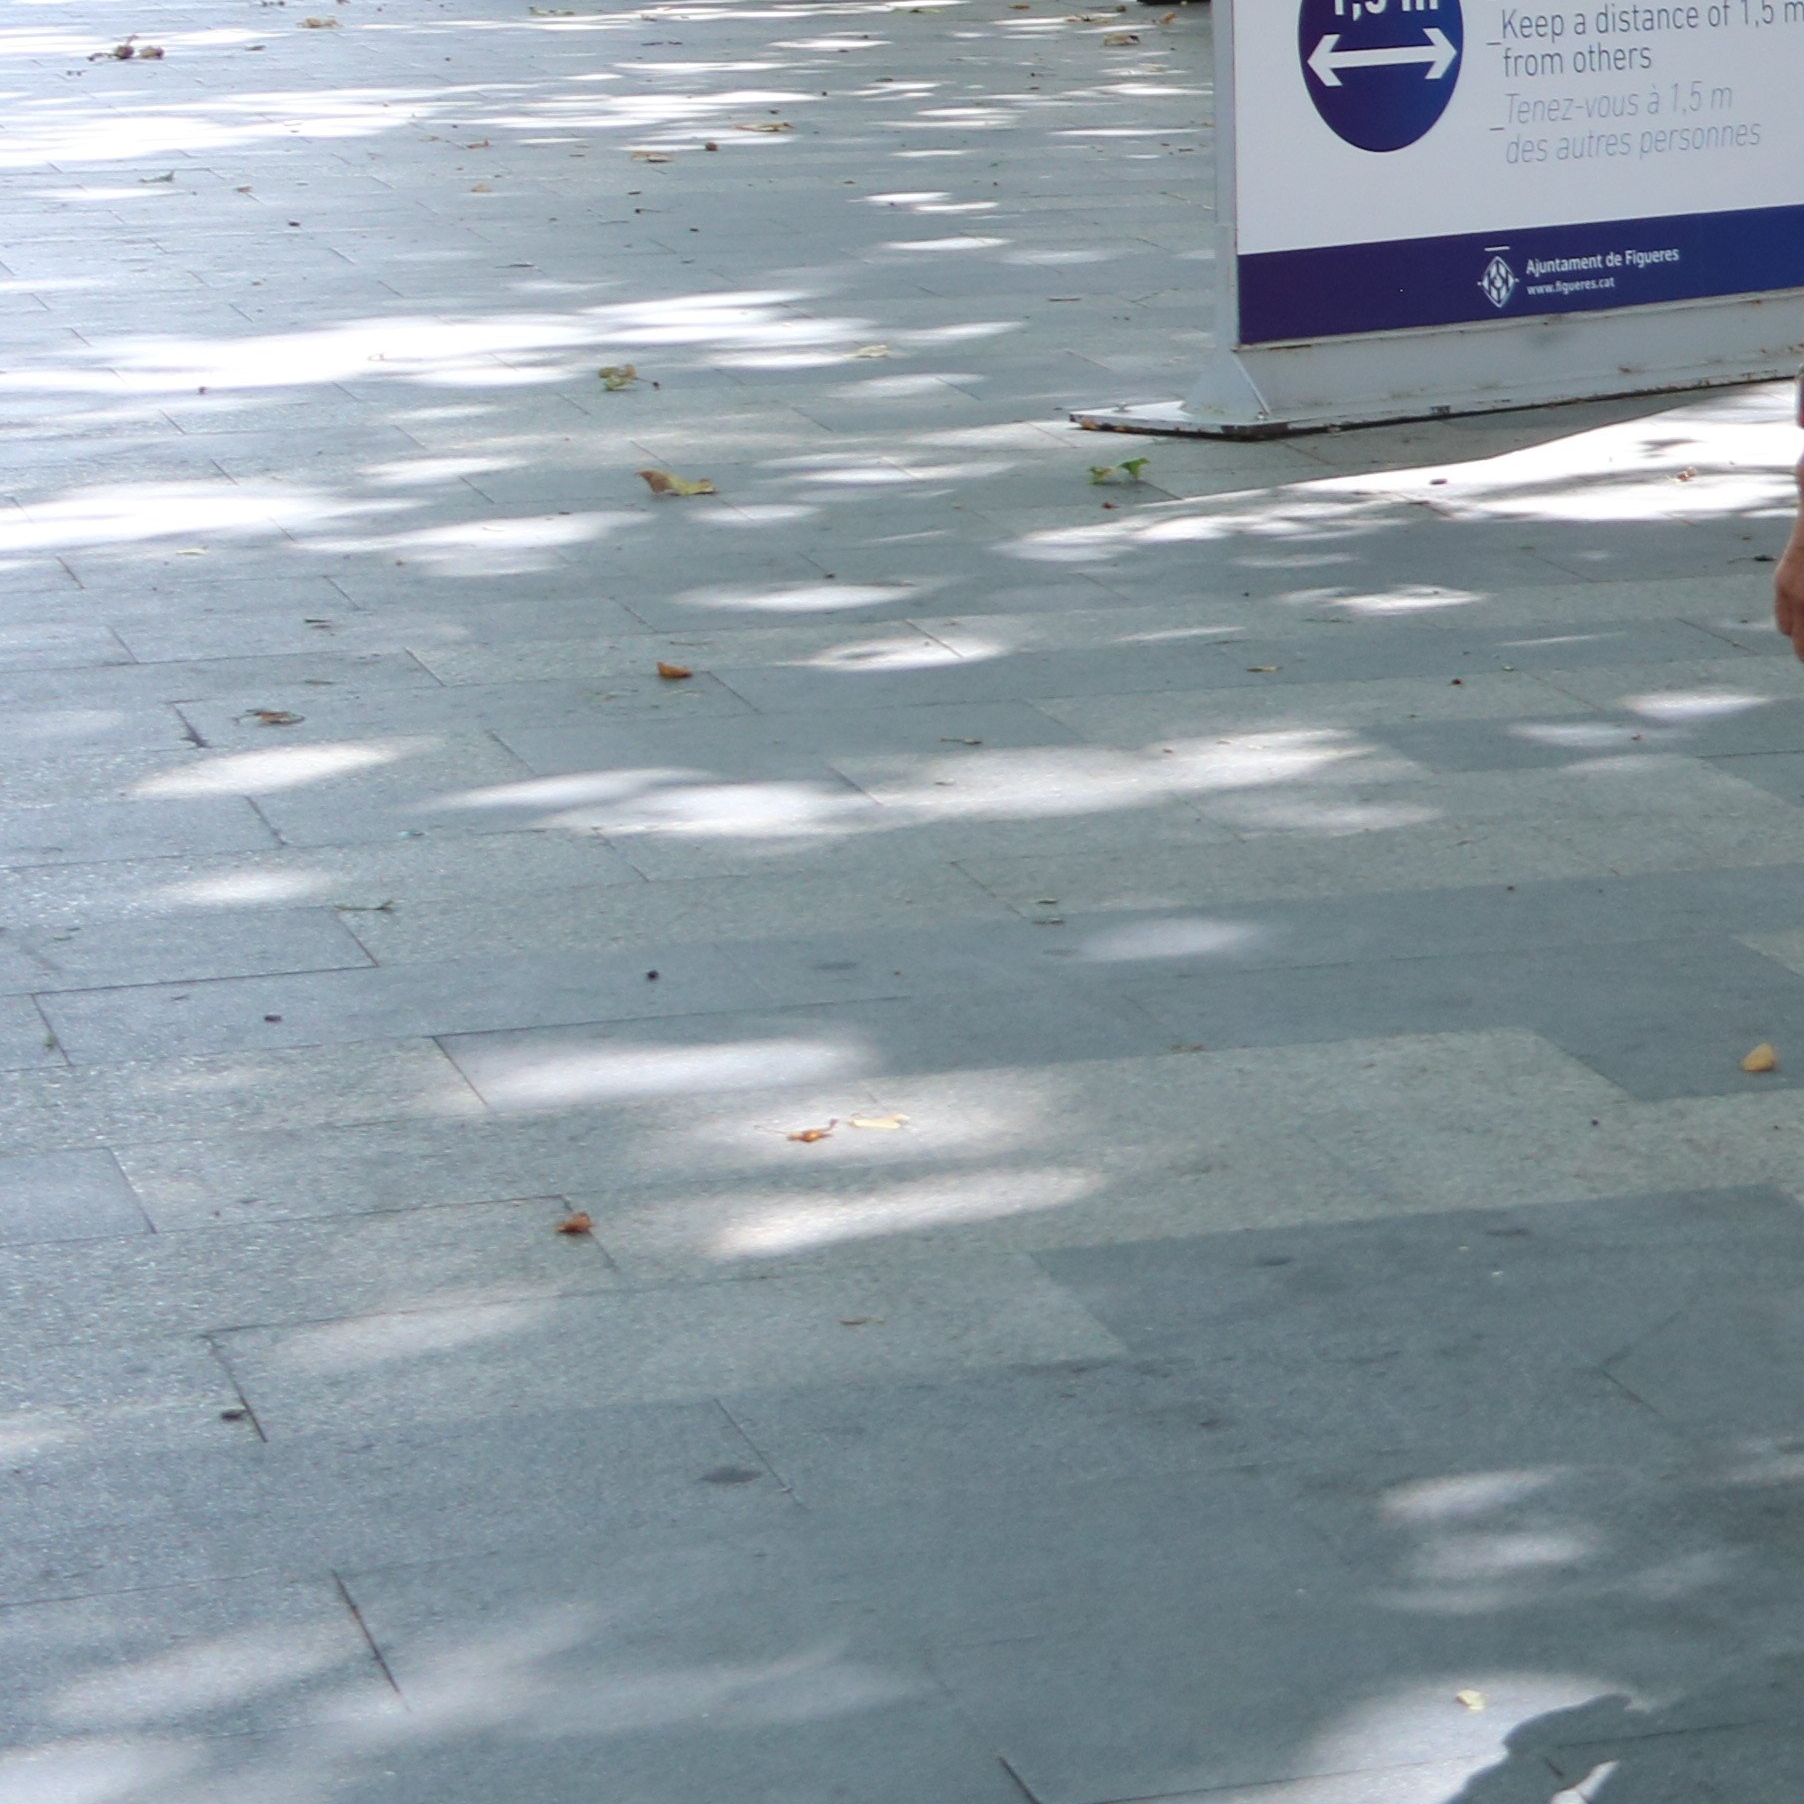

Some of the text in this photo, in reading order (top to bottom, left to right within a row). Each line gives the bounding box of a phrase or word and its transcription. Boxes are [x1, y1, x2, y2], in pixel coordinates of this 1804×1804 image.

[1573, 12, 1587, 36] a
[1595, 4, 1699, 34] distance
[1503, 42, 1652, 77] from others
[1647, 84, 1660, 115] à
[1671, 81, 1703, 115] 1,5
[1710, 86, 1733, 109] m
[1506, 122, 1762, 165] des autres personnes
[1526, 248, 1680, 277] Ajuntament de Figueres
[1527, 274, 1615, 295] www.figueres.cat
